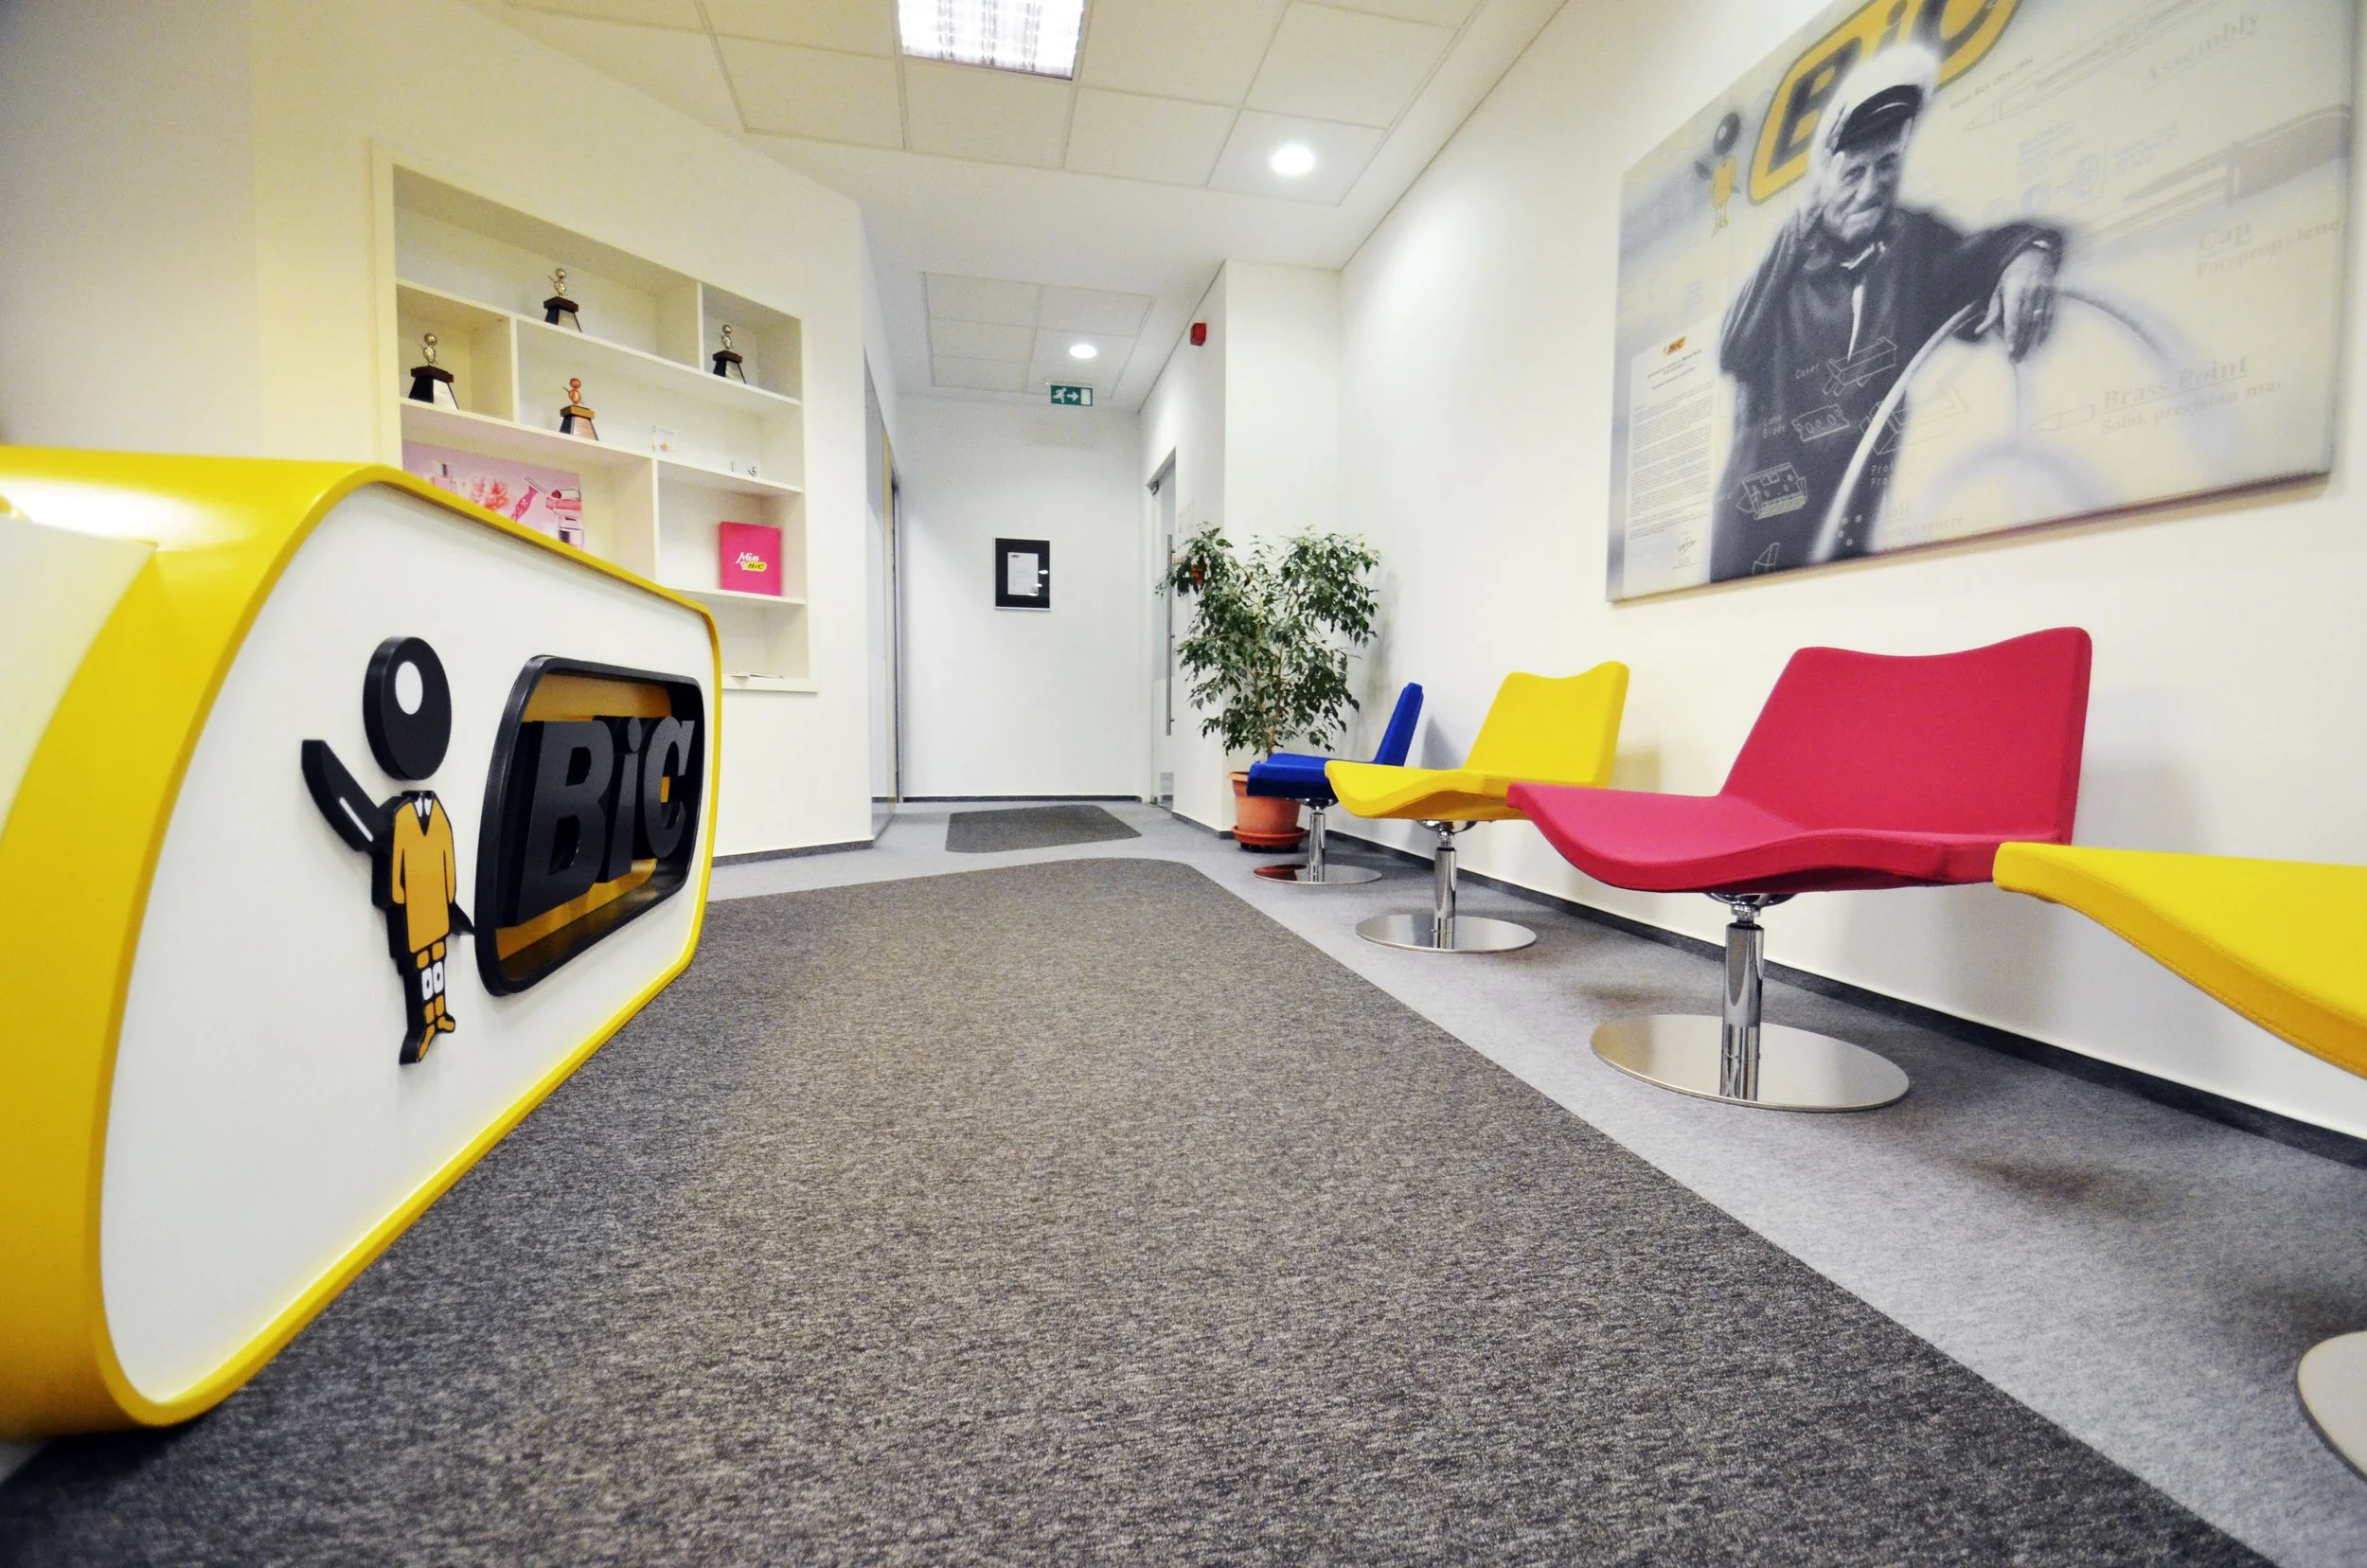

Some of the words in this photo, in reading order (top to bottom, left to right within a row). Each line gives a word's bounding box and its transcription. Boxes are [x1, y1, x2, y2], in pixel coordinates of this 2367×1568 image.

[2197, 222, 2252, 252] Cap
[2103, 380, 2170, 411] Brass
[2178, 355, 2248, 391] Point
[517, 716, 696, 928] BiC
